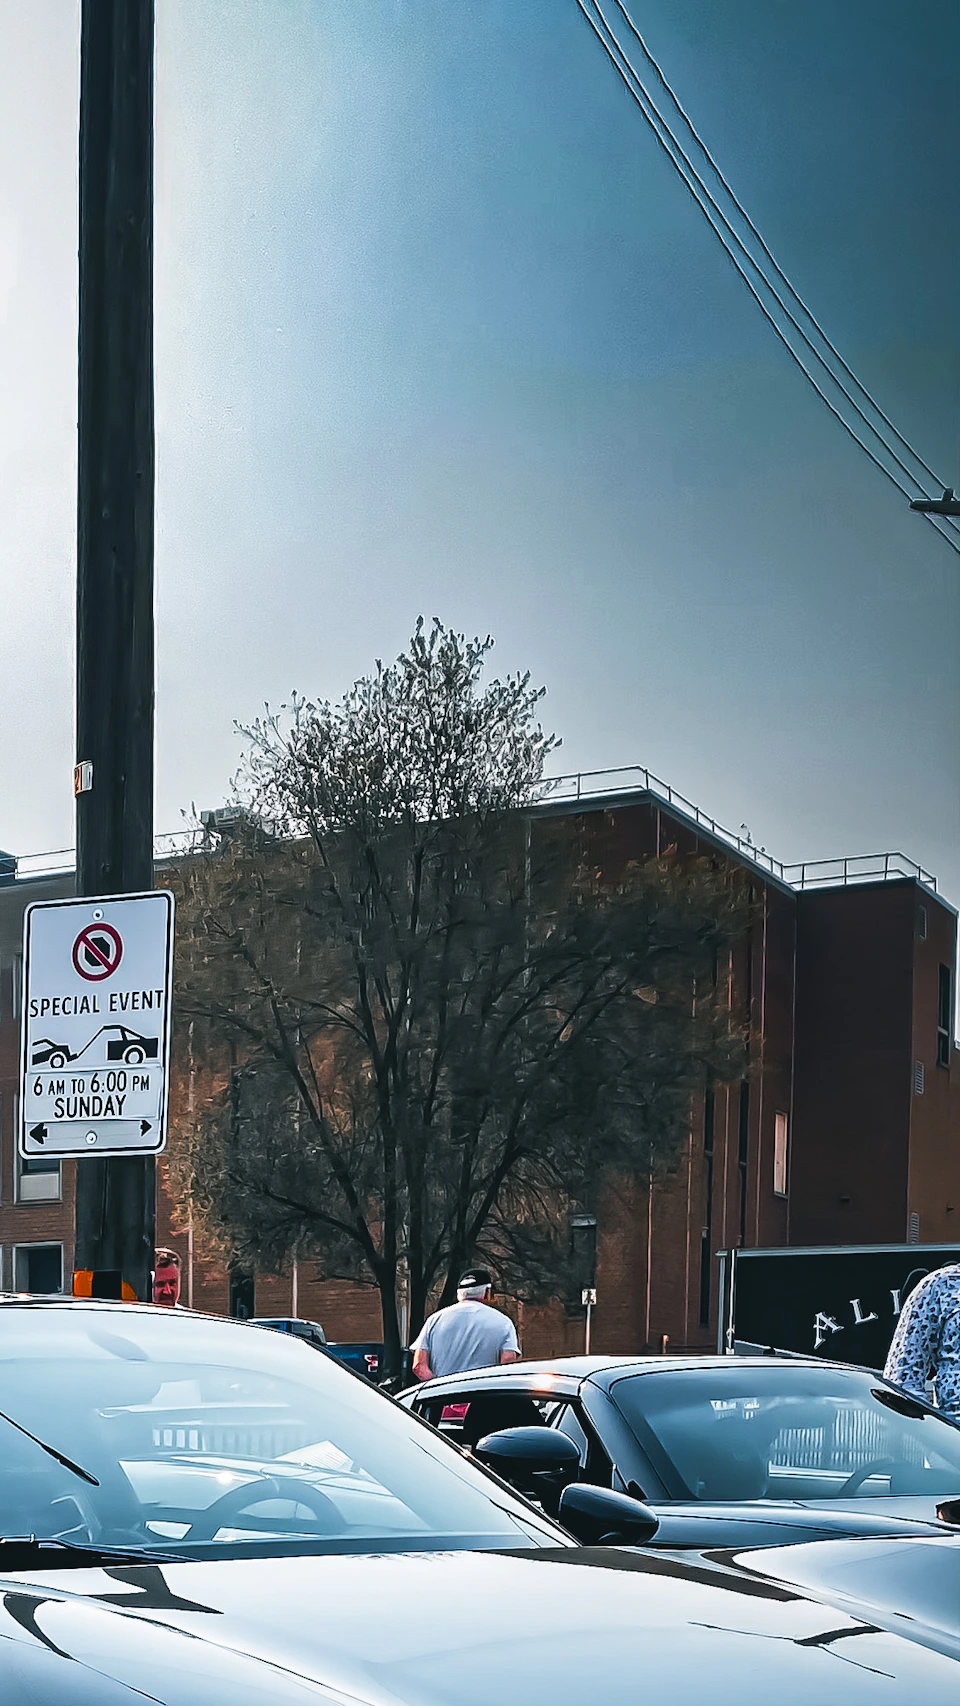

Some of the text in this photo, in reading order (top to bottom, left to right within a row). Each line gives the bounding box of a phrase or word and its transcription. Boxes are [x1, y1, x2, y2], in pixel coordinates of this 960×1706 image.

[30, 990, 164, 1017] SPECIAL EVENT
[33, 1071, 149, 1096] 6 AM TO 6:00 PM
[54, 1094, 126, 1118] SUNDAY
